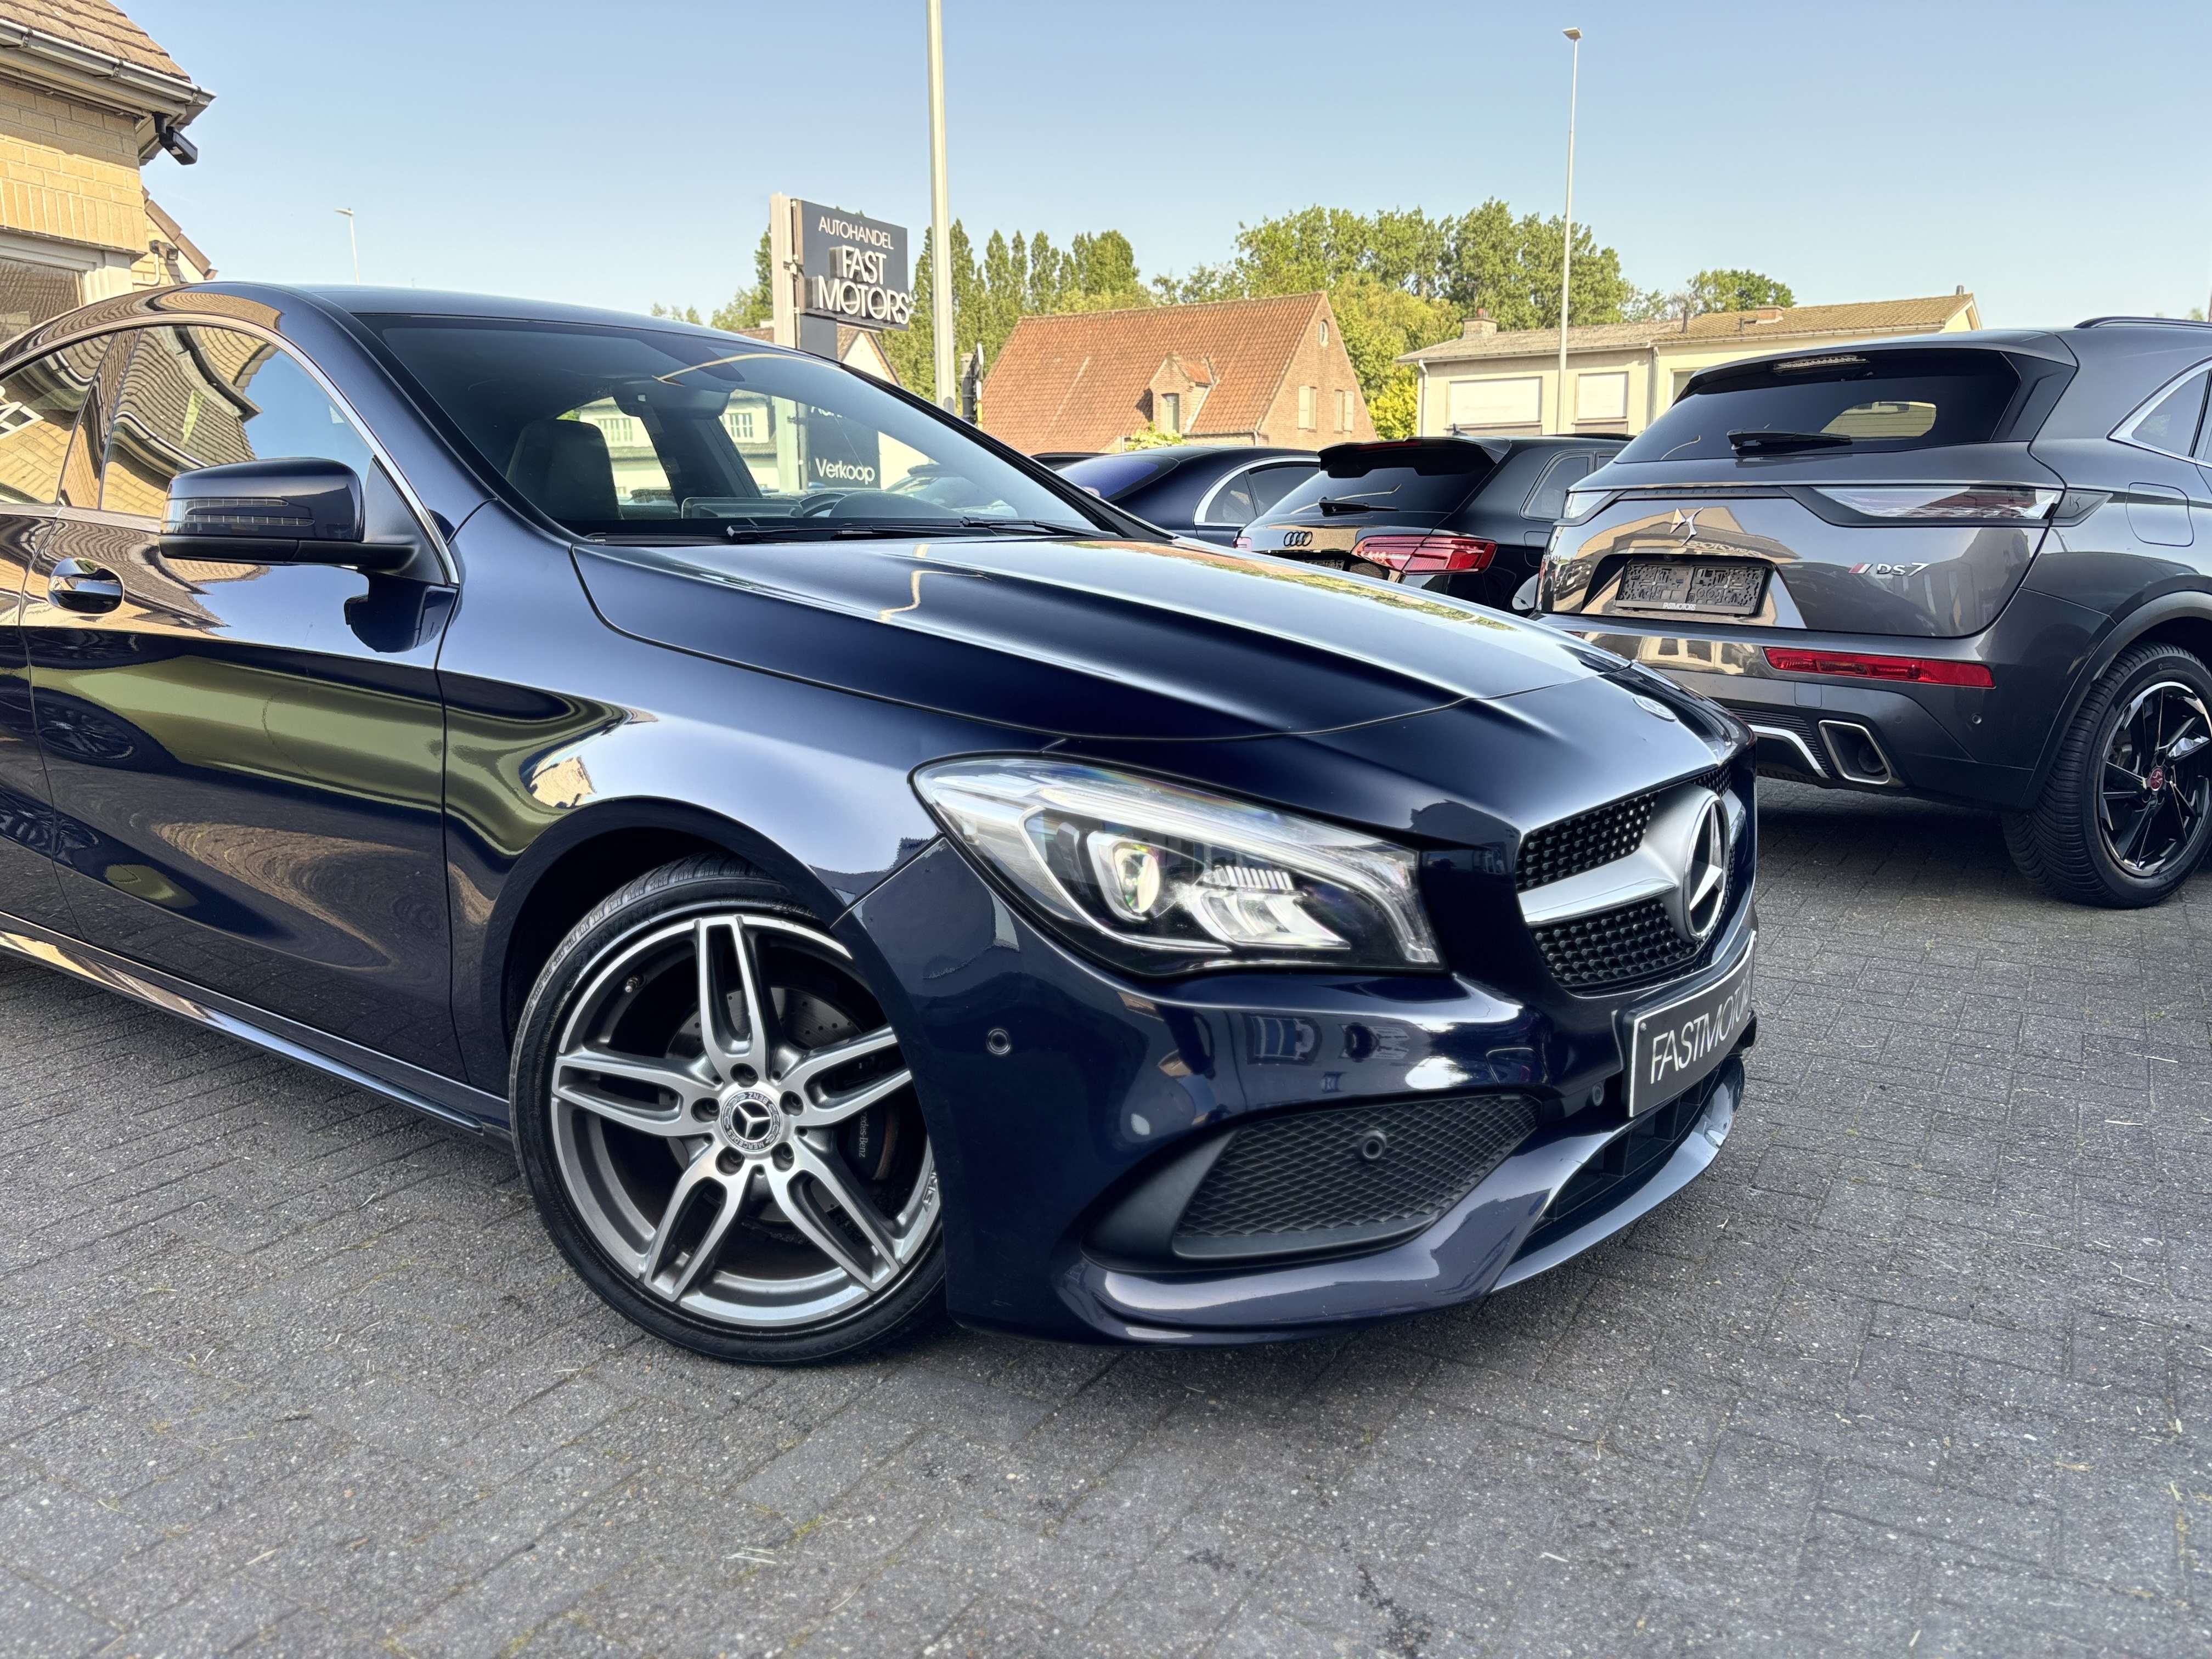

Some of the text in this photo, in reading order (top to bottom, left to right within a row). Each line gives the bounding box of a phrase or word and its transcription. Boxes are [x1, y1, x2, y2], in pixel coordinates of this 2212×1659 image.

[818, 216, 894, 250] AUTOHANDEL
[841, 245, 887, 285] FAST
[818, 275, 910, 325] MOTORS
[815, 457, 876, 485] Verkoop
[748, 1092, 769, 1105] BENZ
[727, 1129, 765, 1150] MERCEDES
